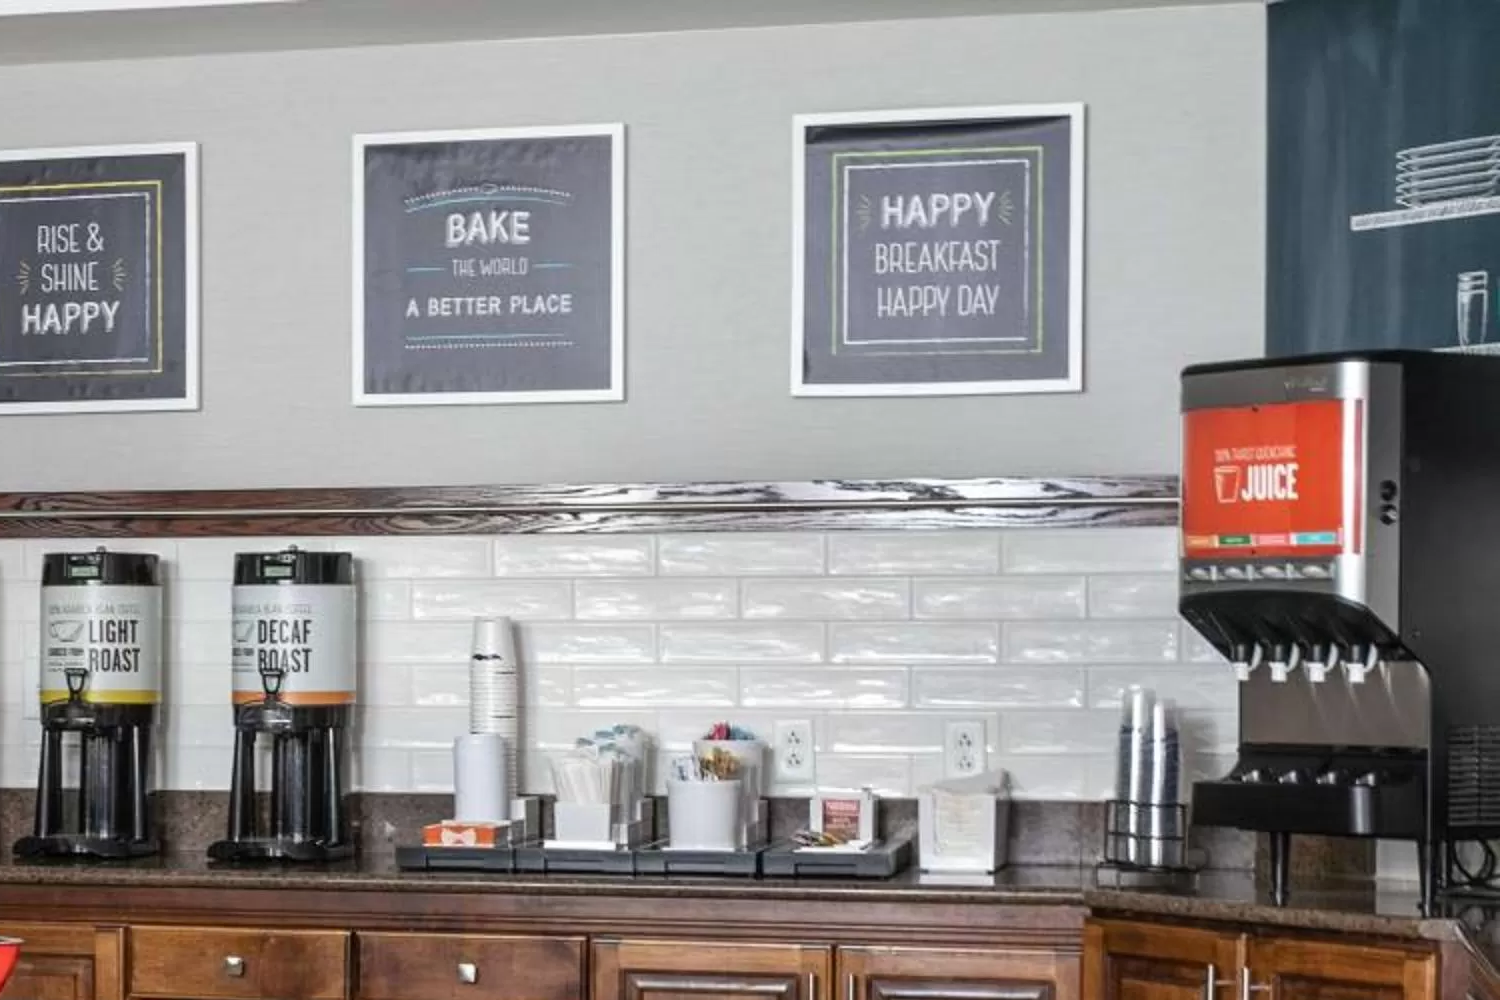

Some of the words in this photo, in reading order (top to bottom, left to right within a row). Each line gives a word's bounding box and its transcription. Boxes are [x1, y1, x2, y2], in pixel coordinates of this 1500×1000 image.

[880, 191, 996, 230] HAPPY
[37, 223, 80, 253] RISE
[86, 222, 105, 252] &
[446, 210, 531, 248] BAKE
[452, 258, 476, 277] THE
[479, 257, 529, 276] WORLD
[875, 239, 1000, 274] BREAKFAST
[40, 261, 99, 293] SHINE
[406, 298, 420, 317] A
[427, 296, 501, 317] BETTER
[509, 293, 573, 314] PLACE
[877, 286, 951, 318] HAPPY
[957, 283, 1000, 316] DAY
[21, 300, 120, 335] HAPPY
[1241, 462, 1299, 501] JUICE
[89, 619, 139, 645] LIGHT
[257, 619, 313, 645] DECAF
[89, 647, 141, 673] ROAST
[257, 647, 313, 673] ROAST
